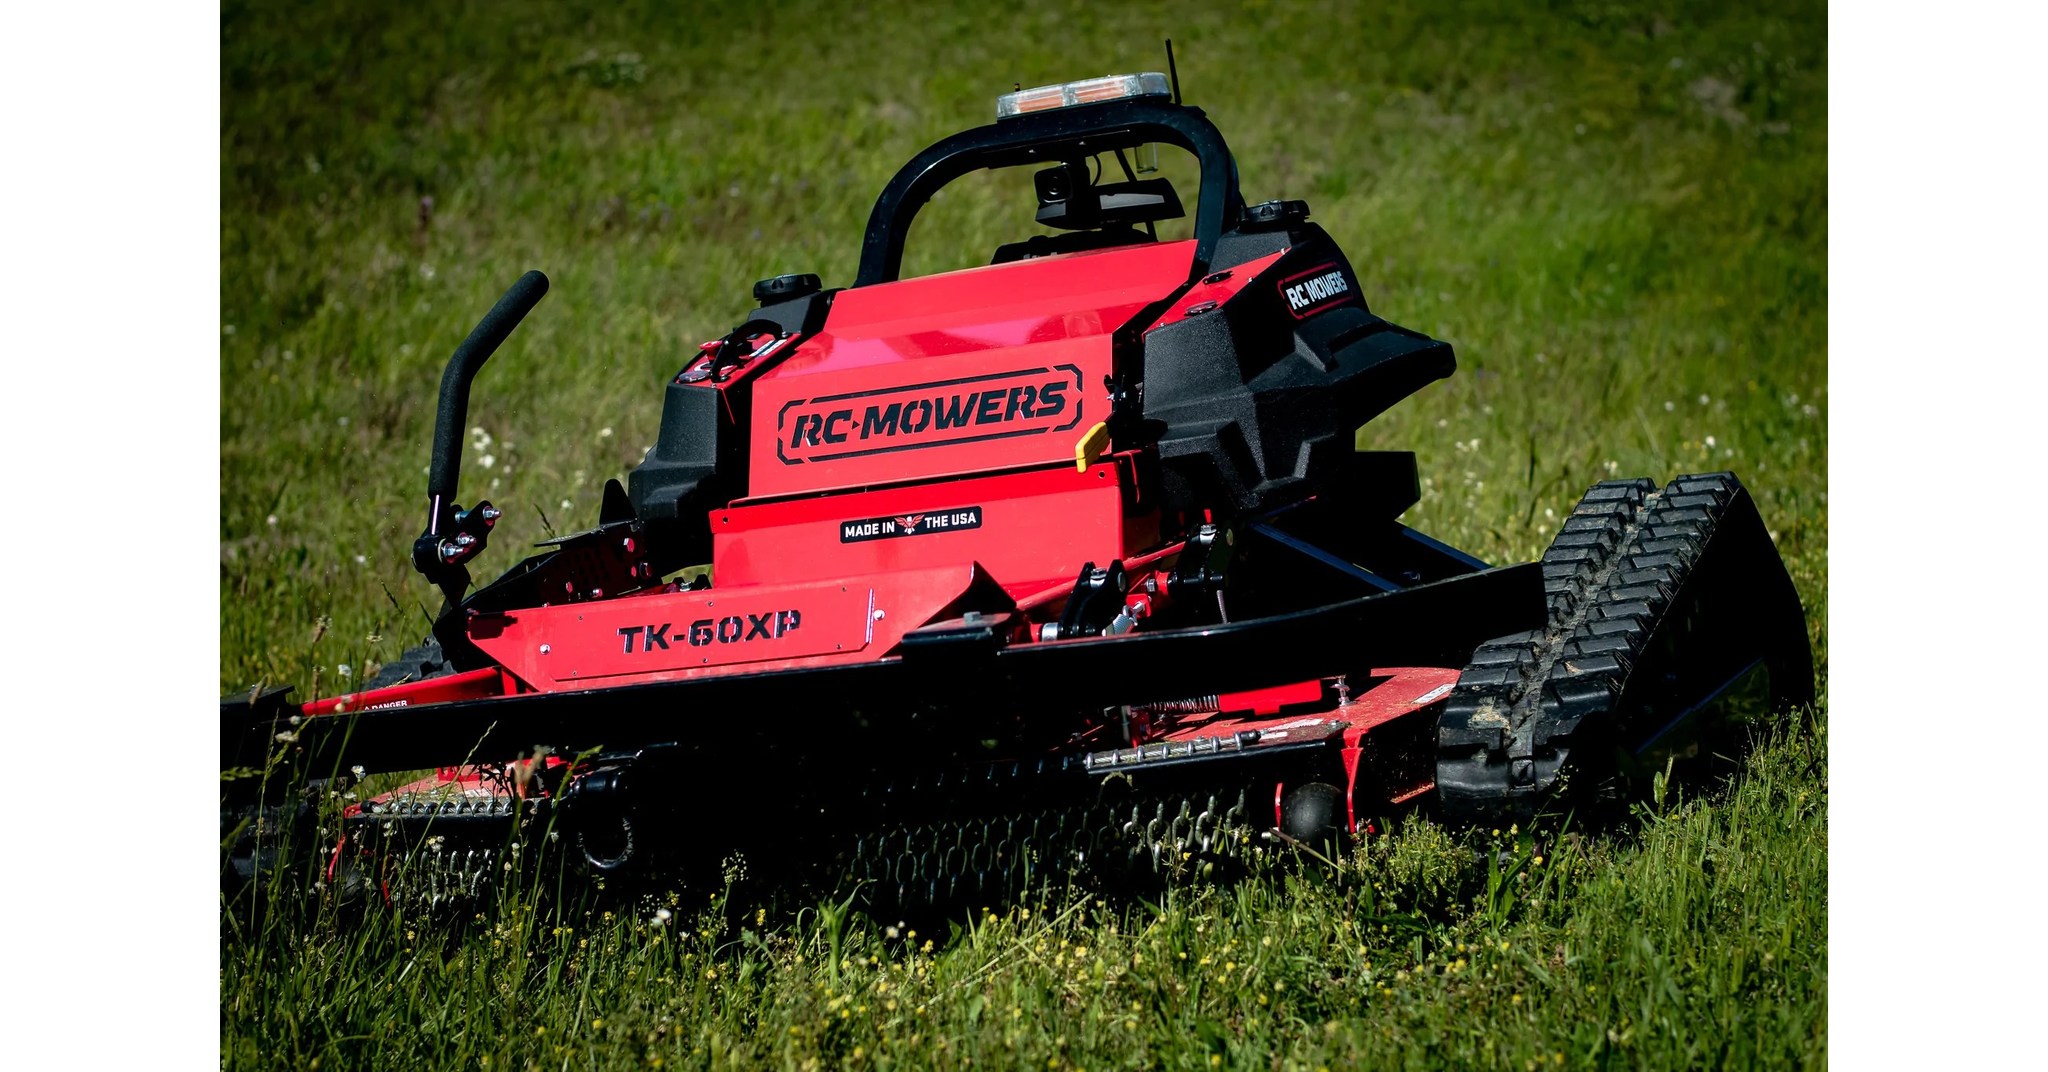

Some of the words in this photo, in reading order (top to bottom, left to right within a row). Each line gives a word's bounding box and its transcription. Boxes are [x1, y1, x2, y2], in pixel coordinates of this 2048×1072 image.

[1286, 284, 1309, 309] RC
[1304, 271, 1348, 301] MOWERS
[791, 409, 853, 448] RC
[860, 381, 1069, 440] MOWERS
[845, 523, 879, 538] MADE
[882, 521, 895, 534] IN
[925, 515, 949, 528] THE
[951, 512, 977, 526] USA
[617, 609, 800, 653] TK-60XP
